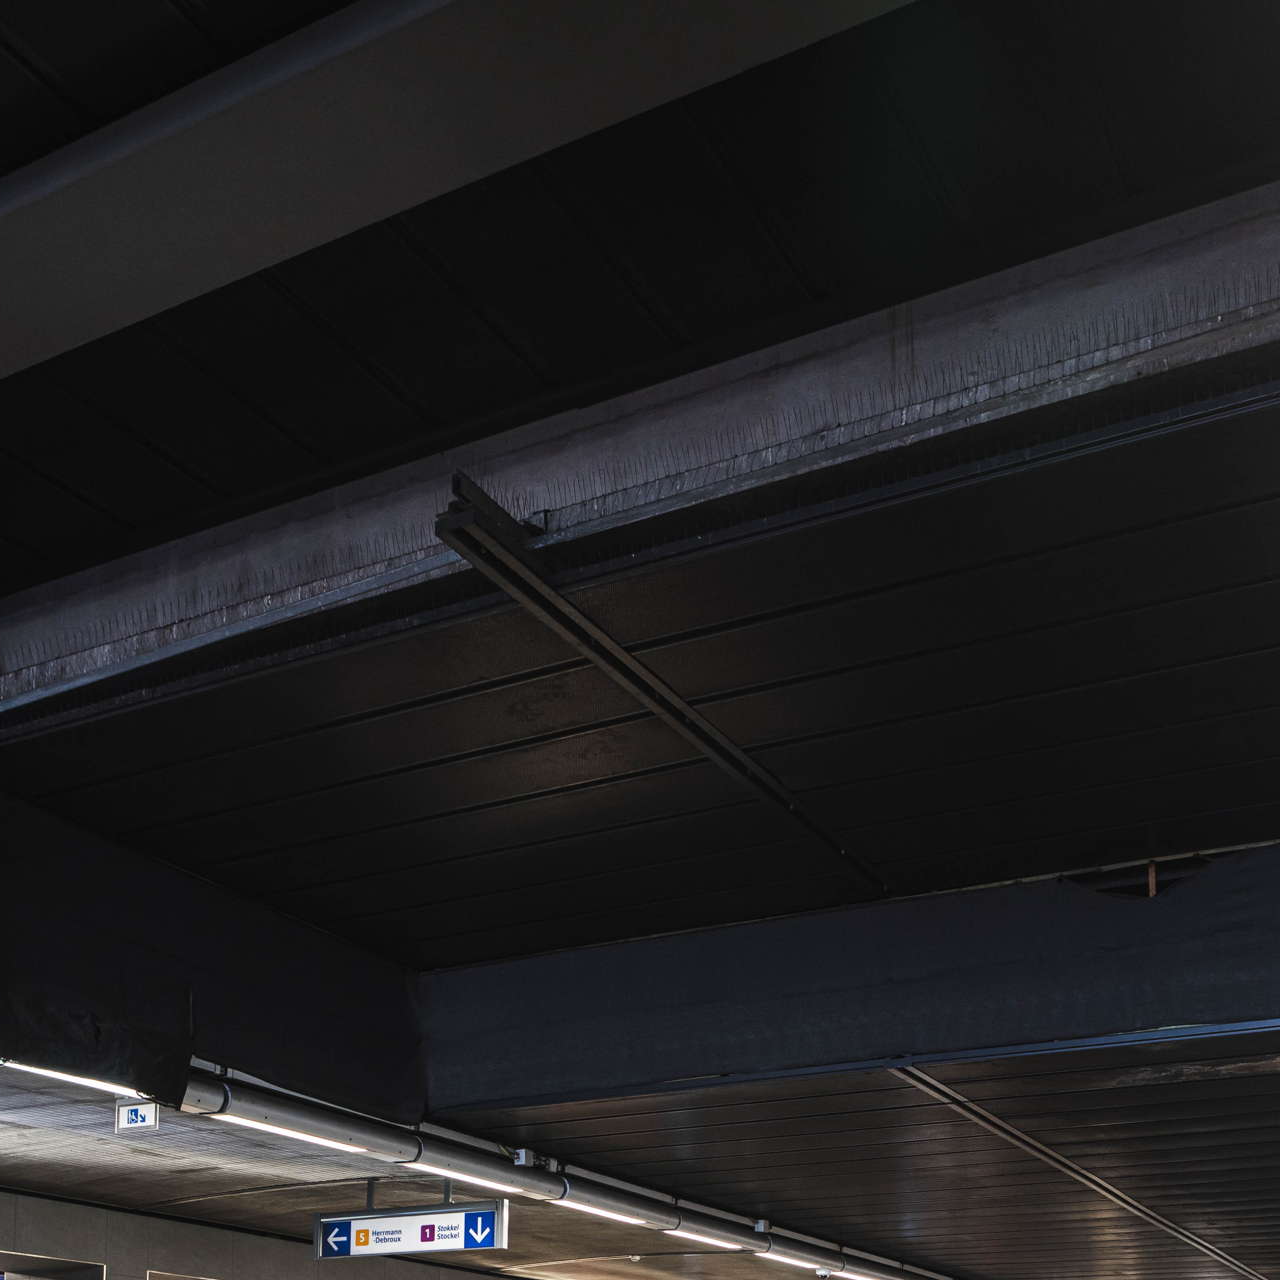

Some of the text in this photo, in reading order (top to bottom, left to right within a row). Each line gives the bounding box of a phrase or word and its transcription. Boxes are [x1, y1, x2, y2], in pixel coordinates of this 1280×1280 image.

[437, 1224, 460, 1232] Stokkel
[372, 1229, 402, 1237] Herrmann
[437, 1232, 460, 1240] Stockel
[373, 1236, 401, 1244] -Debroux
